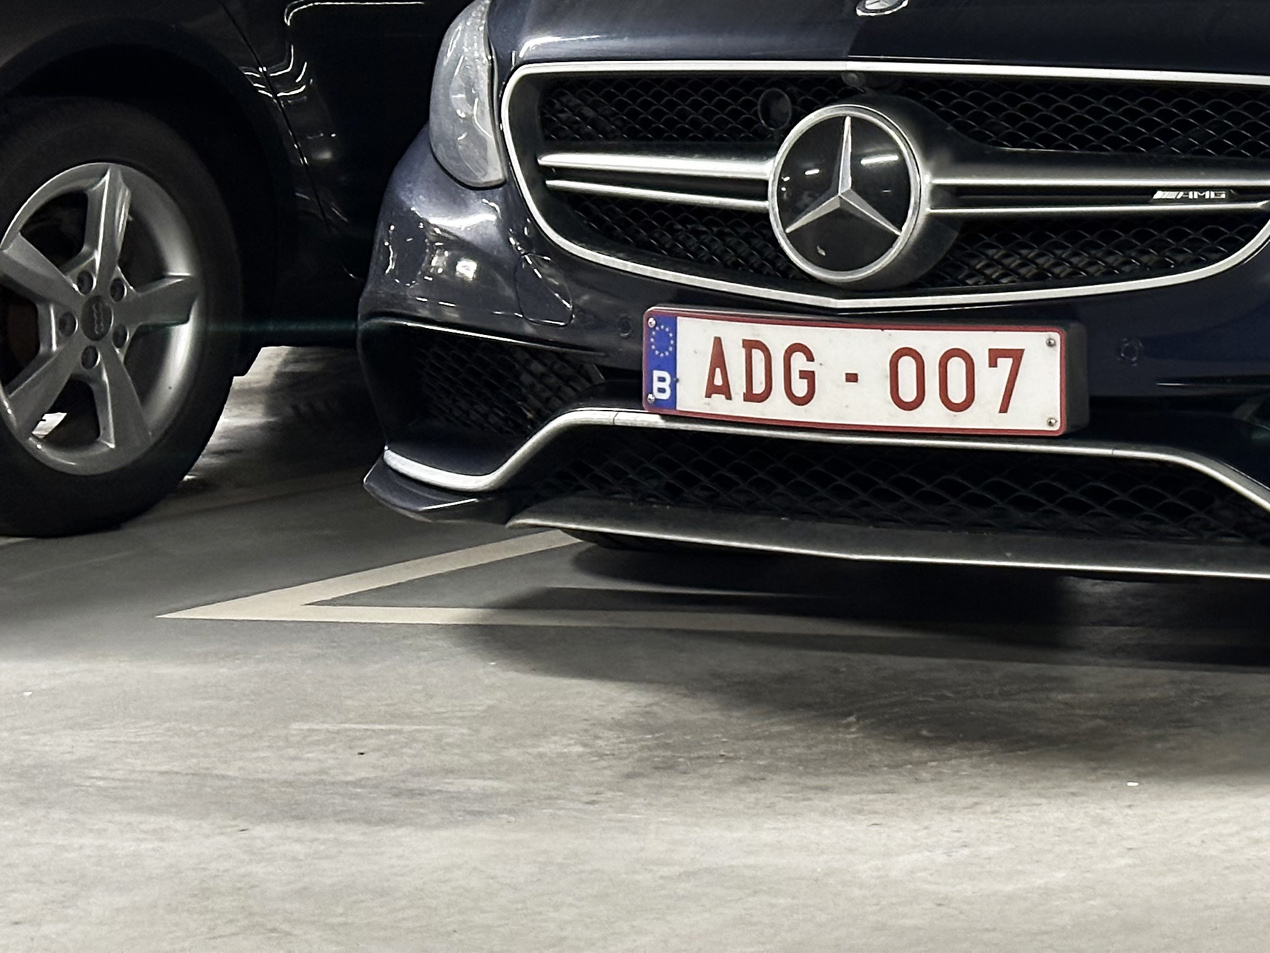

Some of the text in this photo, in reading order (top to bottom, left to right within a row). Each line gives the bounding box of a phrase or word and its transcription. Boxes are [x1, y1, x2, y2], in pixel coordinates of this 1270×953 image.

[1176, 190, 1226, 199] AMG
[653, 370, 671, 401] B
[704, 336, 816, 407] ADG
[888, 346, 1025, 414] 007
